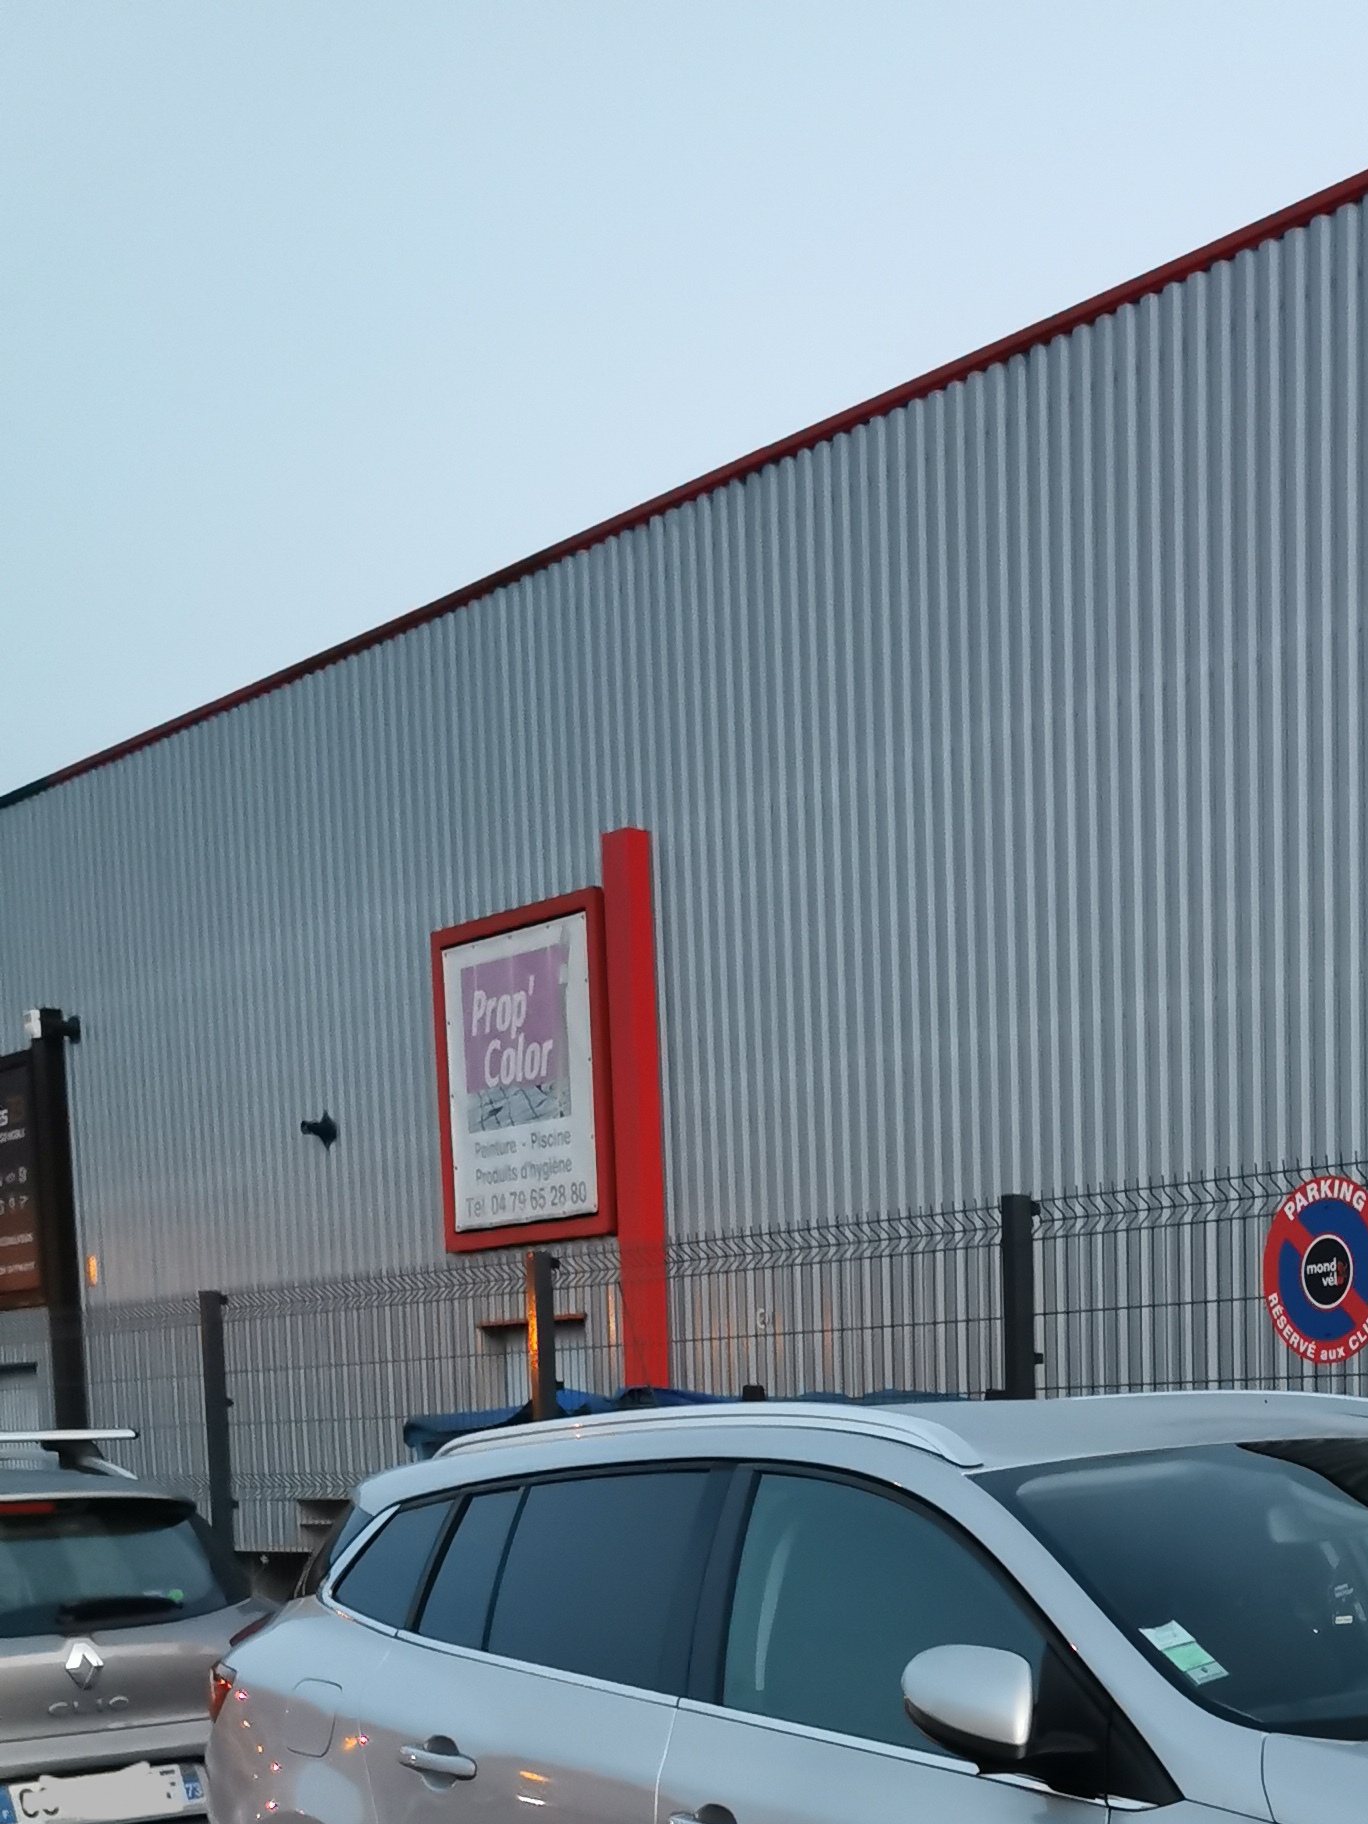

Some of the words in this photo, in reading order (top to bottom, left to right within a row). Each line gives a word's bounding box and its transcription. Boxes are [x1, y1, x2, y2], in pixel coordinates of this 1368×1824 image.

[471, 974, 535, 1039] Prop'
[484, 1032, 553, 1088] Color
[530, 1130, 571, 1150] Piscine
[475, 1164, 518, 1186] Produits
[490, 1193, 507, 1215] 04
[509, 1189, 527, 1212] 79
[529, 1187, 547, 1212] 65
[550, 1183, 567, 1207] 28
[570, 1180, 588, 1205] 80
[1284, 1178, 1367, 1221] PARKING
[1267, 1292, 1317, 1359] RÉSERVÉ
[1320, 1346, 1346, 1361] aux
